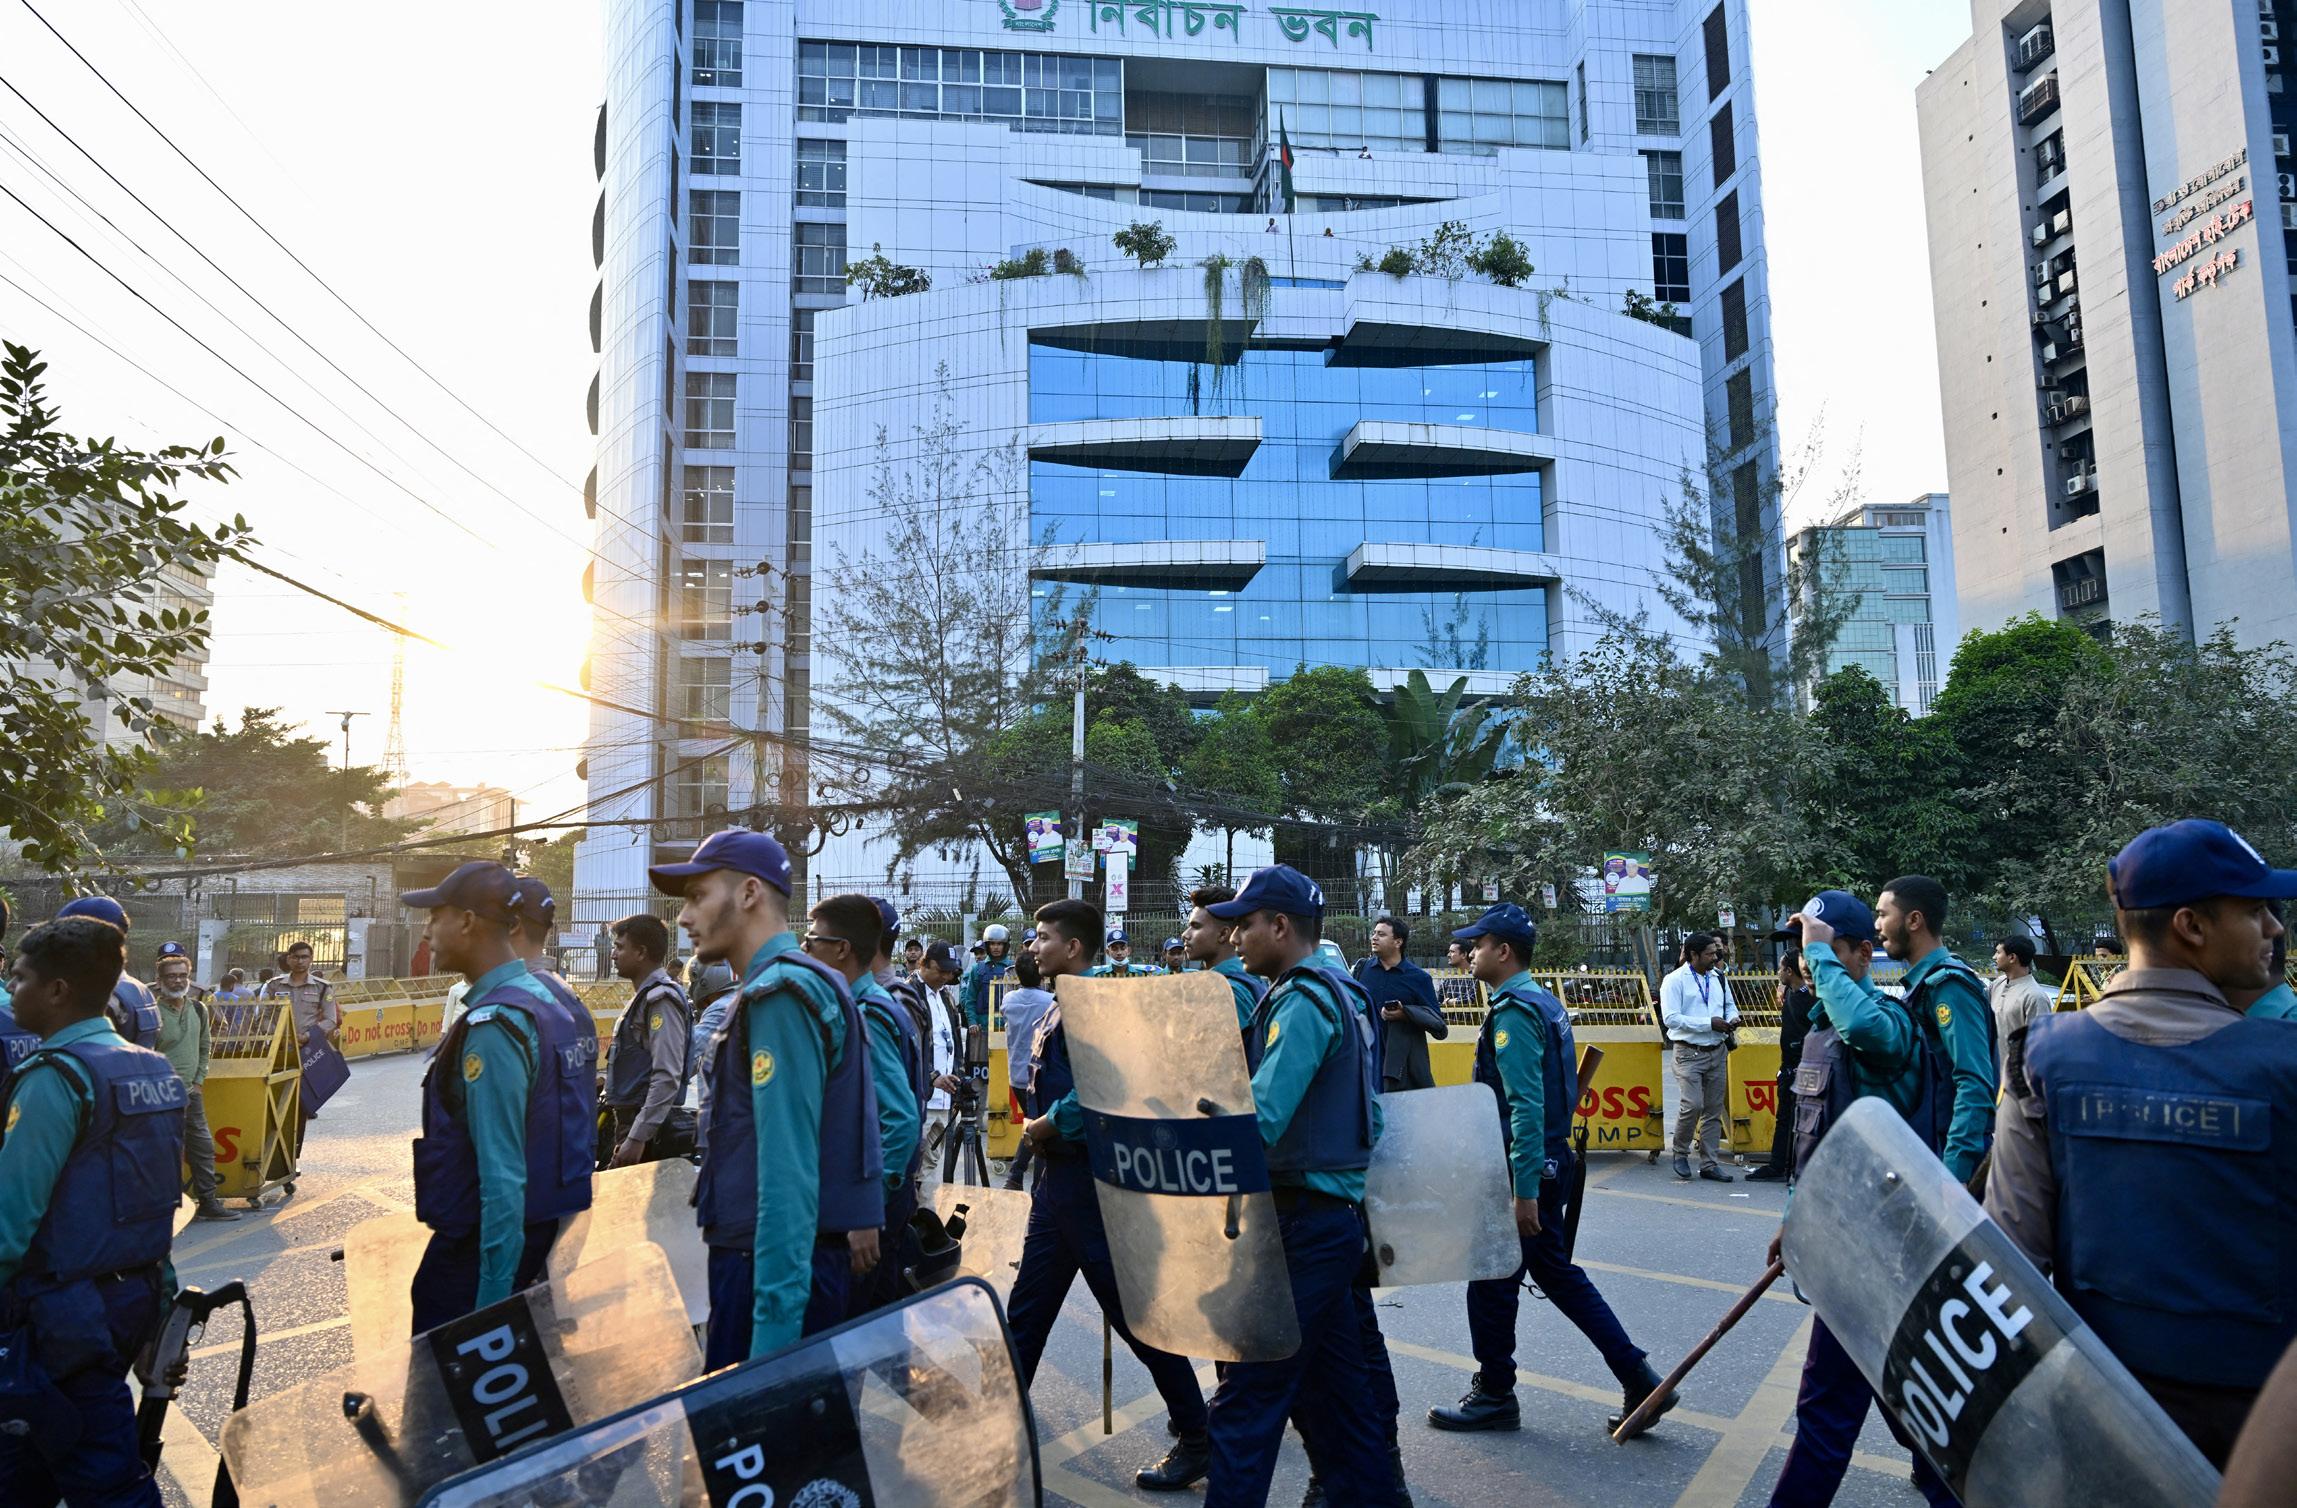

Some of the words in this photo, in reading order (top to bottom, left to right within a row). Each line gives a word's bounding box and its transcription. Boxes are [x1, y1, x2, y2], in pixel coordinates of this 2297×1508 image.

[1268, 7, 1381, 52] ভবন
[2152, 230, 2201, 274] বাংলাদেশ
[2172, 265, 2196, 299] পার্ক
[347, 1026, 361, 1045] Do
[364, 1023, 381, 1041] not
[384, 1021, 413, 1038] cross
[431, 1021, 442, 1034] no
[303, 1048, 326, 1071] POLICE
[2096, 1097, 2220, 1131] PLICE
[1113, 1141, 1239, 1193] POLICE
[456, 1324, 548, 1449] POLI
